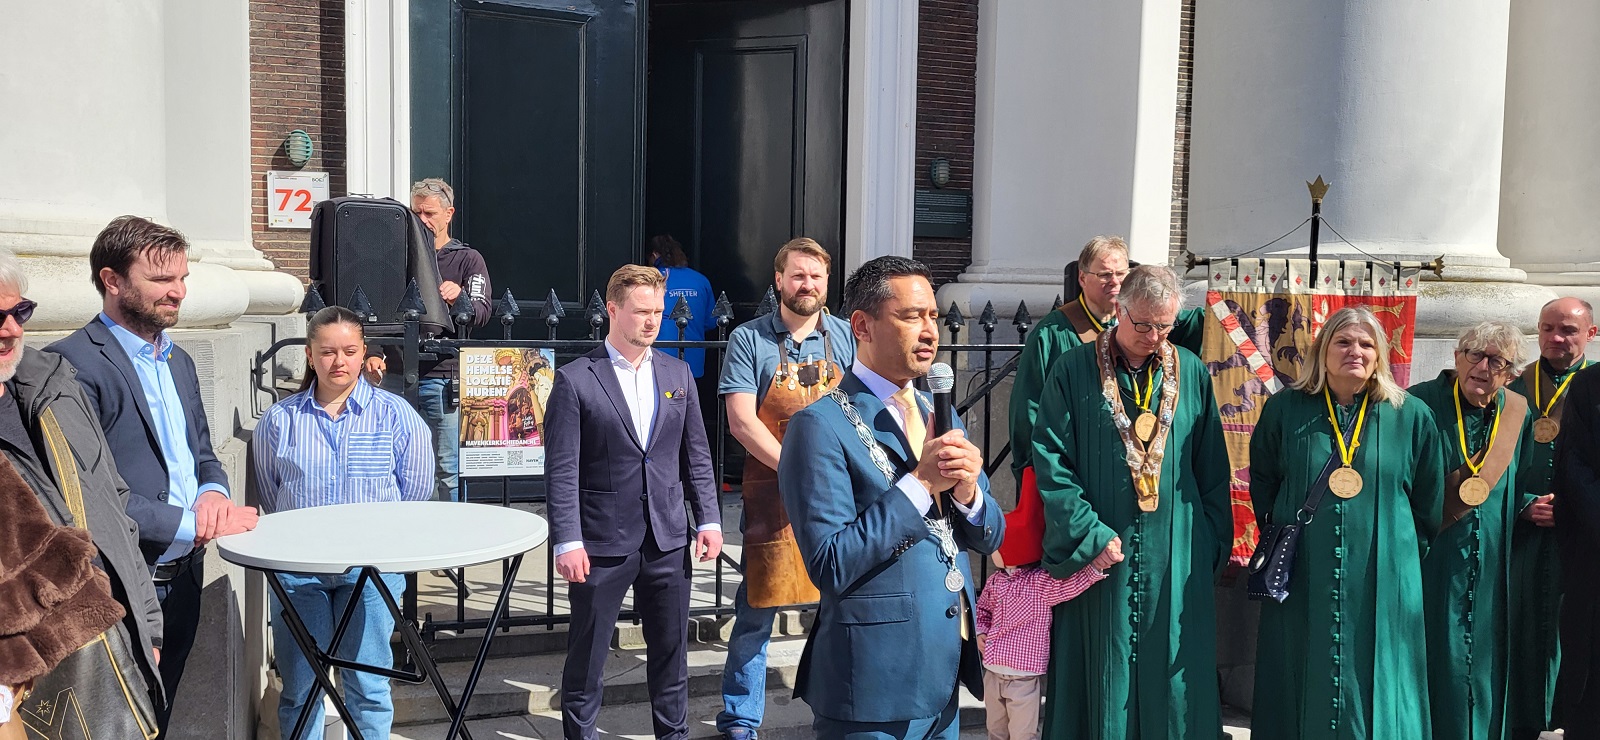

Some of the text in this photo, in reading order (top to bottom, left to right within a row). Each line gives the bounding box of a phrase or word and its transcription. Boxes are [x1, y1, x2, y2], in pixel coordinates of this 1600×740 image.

[275, 188, 312, 212] 72
[668, 290, 698, 298] SHELTER
[466, 354, 493, 364] DEZE
[466, 365, 513, 375] HEMELSE
[466, 376, 511, 386] LOCATIE
[466, 387, 508, 397] HUREN?
